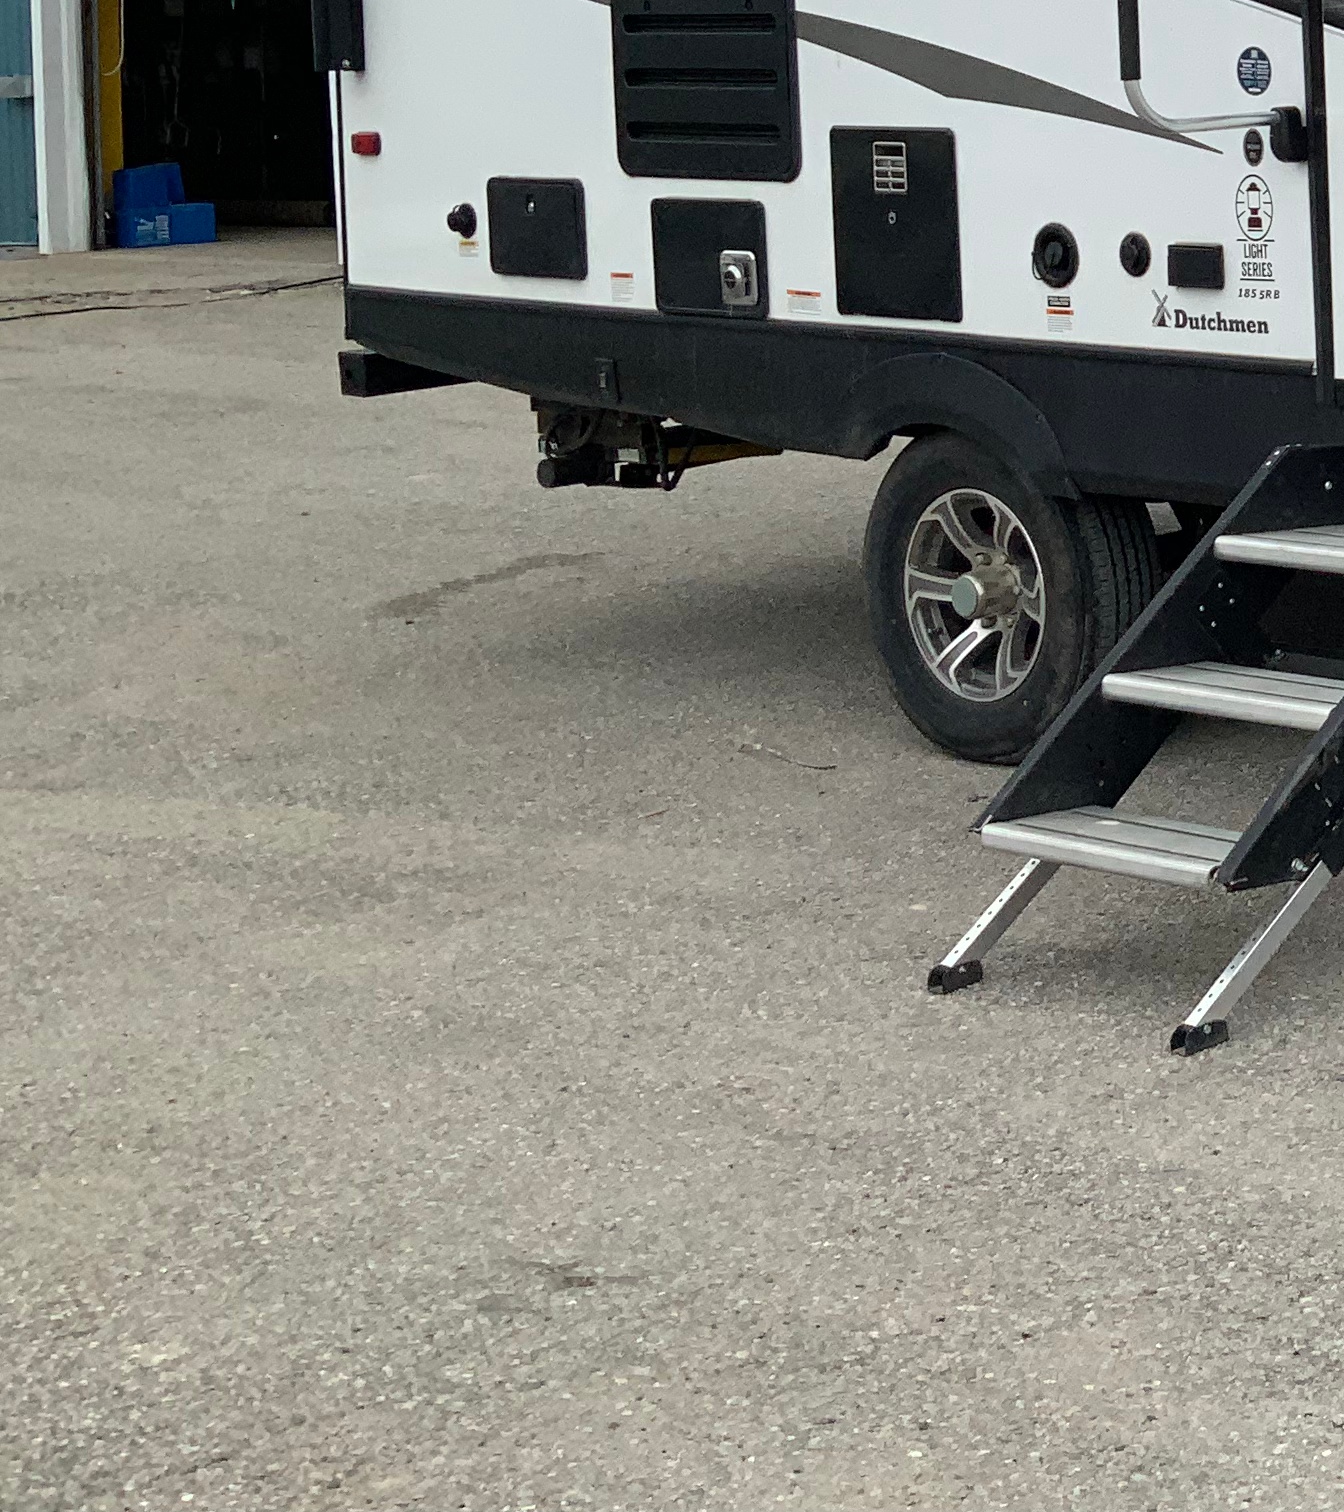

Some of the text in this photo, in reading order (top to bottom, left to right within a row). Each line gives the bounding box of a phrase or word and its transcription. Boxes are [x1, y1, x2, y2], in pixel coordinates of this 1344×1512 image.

[1243, 243, 1268, 259] LIGHT
[1241, 261, 1273, 278] SERIES
[1174, 309, 1269, 335] Dutchmen
